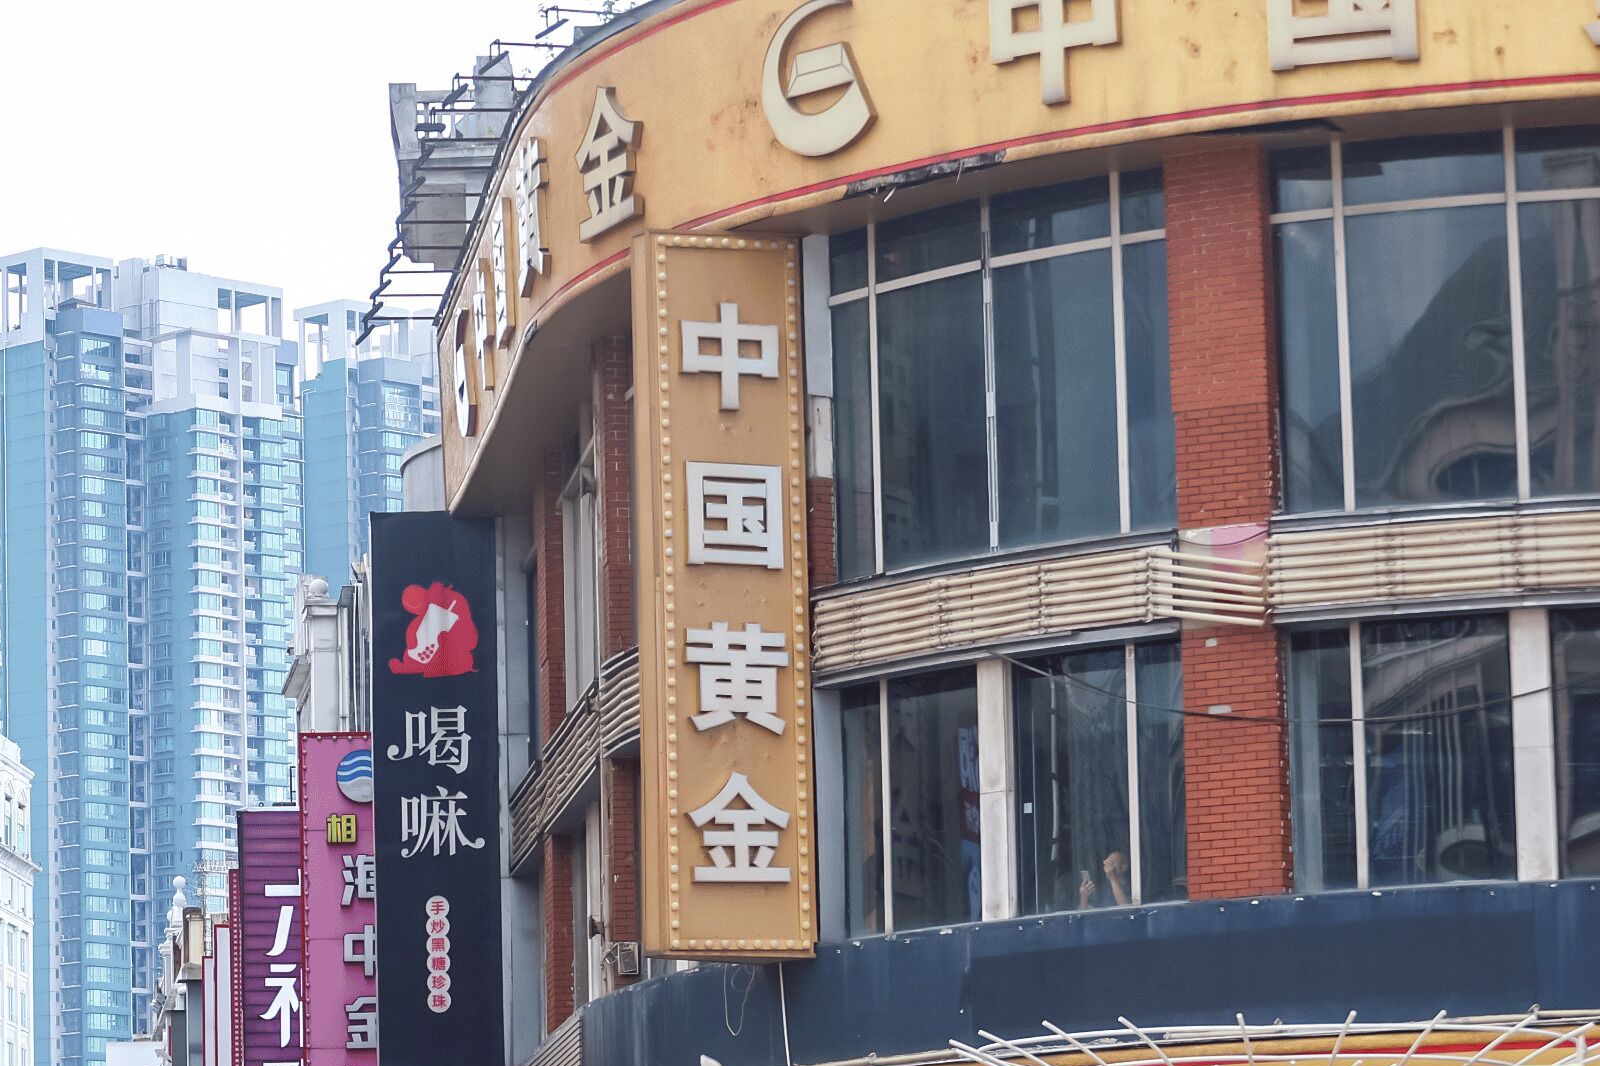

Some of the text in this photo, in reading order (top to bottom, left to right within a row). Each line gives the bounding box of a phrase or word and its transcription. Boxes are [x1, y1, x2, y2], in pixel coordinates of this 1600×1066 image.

[678, 302, 791, 884] 中国黄金
[387, 705, 485, 858] 喝嘛
[429, 900, 447, 1008] 手炒黑糖珍珠
